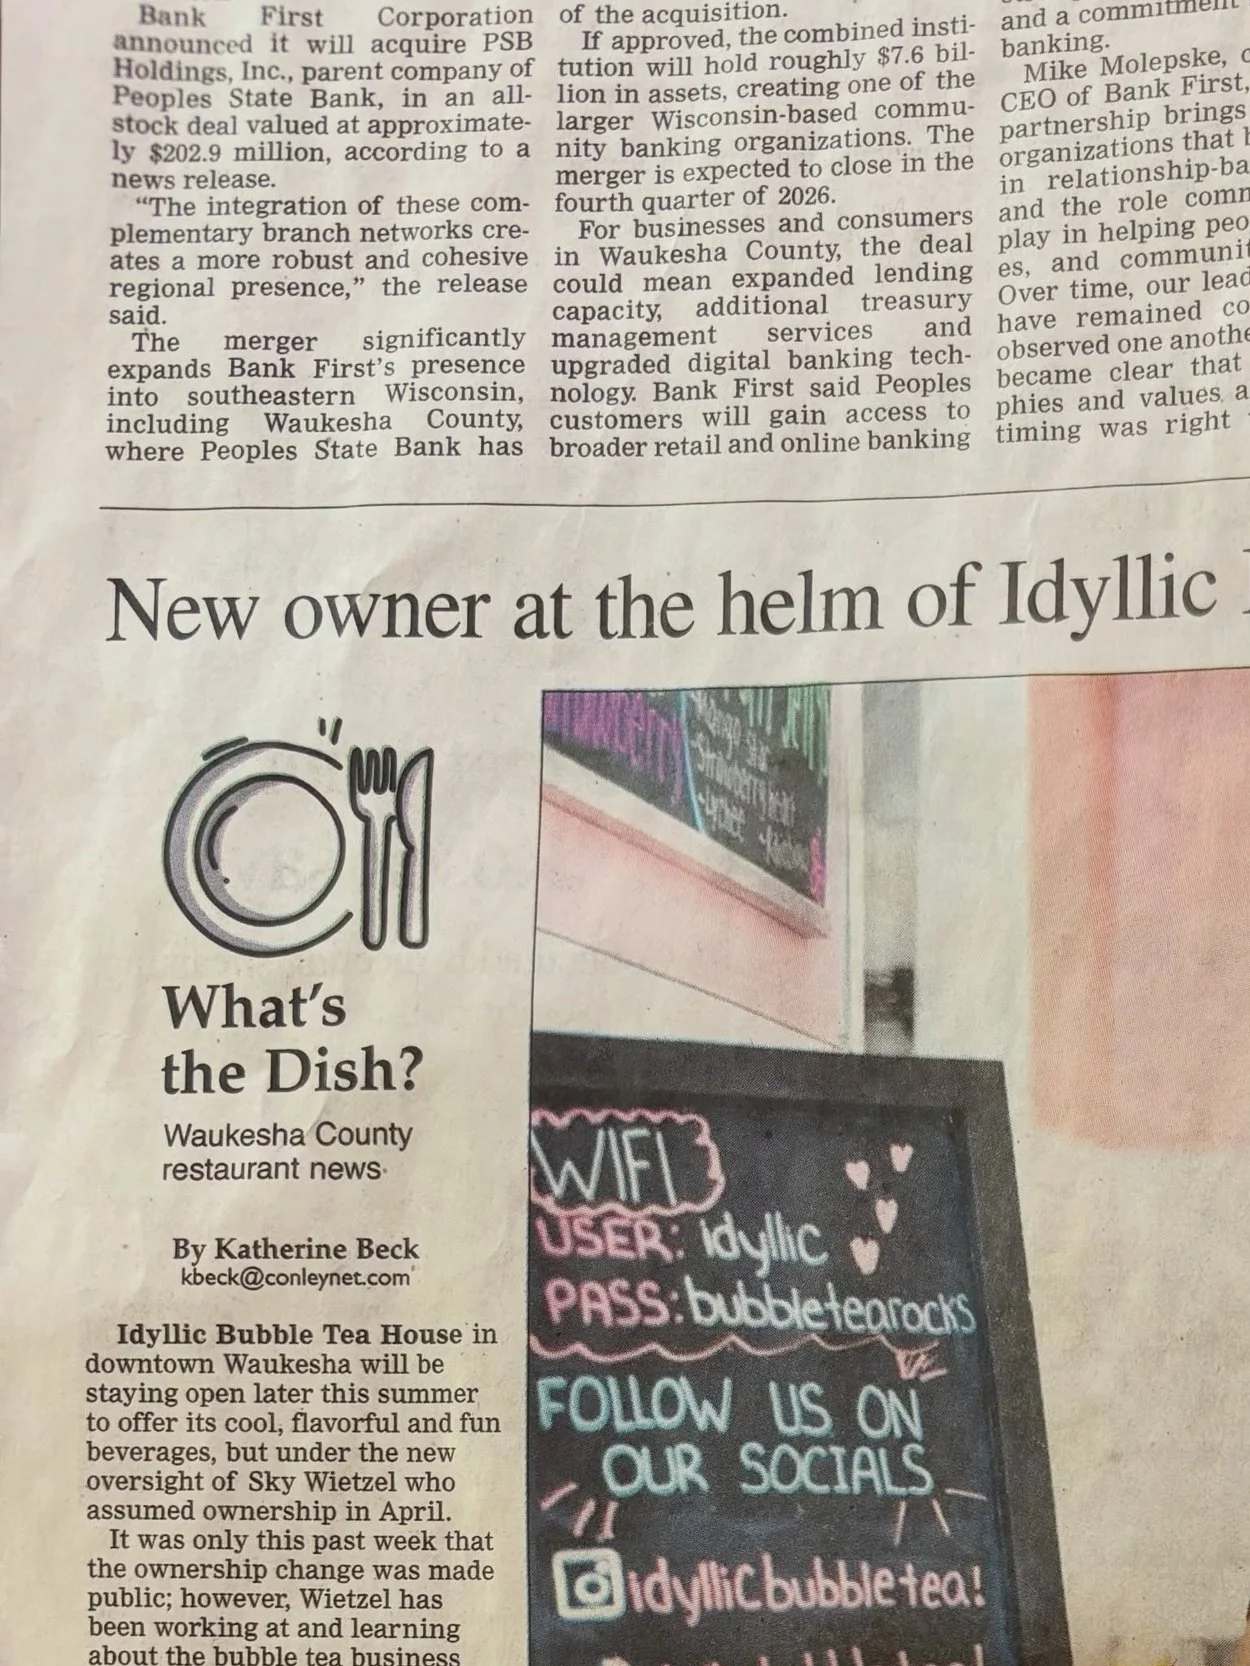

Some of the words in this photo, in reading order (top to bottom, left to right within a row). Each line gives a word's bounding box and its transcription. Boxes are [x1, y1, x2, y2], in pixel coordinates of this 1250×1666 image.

[1001, 32, 1109, 58] banking.
[112, 139, 136, 164] ly
[150, 143, 220, 164] $202.9
[234, 141, 330, 164] million,
[345, 142, 467, 162] according
[480, 140, 502, 158] to
[517, 142, 530, 158] a
[555, 192, 634, 212] fourth
[642, 190, 734, 215] quarter
[743, 185, 768, 205] of
[778, 186, 835, 205] 2026.
[108, 386, 158, 406] into
[188, 384, 355, 406] southeastern
[386, 382, 523, 404] Wisconsin,
[106, 578, 259, 641] New
[285, 593, 491, 639] owner
[514, 583, 573, 639] at
[596, 574, 694, 639] the
[718, 570, 883, 635] helm
[908, 561, 982, 627] of
[1000, 553, 1217, 641] Idyllic
[162, 1049, 245, 1094] the
[266, 1045, 423, 1092] Dish?
[164, 1122, 306, 1147] Waukesha
[316, 1121, 413, 1152] County
[164, 1158, 300, 1180] restaurant
[310, 1161, 382, 1180] news
[532, 1128, 677, 1203] WIFI
[172, 1238, 206, 1266] By
[214, 1237, 346, 1260] Katherine
[356, 1238, 420, 1260] Beck
[535, 1217, 686, 1262] USER:
[702, 1212, 828, 1278] idyllic
[182, 1266, 414, 1291] kbeck@conleynet.com
[544, 1276, 684, 1329] PASS:
[684, 1274, 977, 1335] bubbletearocks
[117, 1324, 206, 1348] Idyllic
[216, 1324, 313, 1344] Bubble
[323, 1324, 371, 1344] Tea
[380, 1324, 467, 1344] House
[473, 1323, 498, 1344] in
[536, 1374, 733, 1434] FOLLOW
[770, 1380, 835, 1440] US
[857, 1383, 924, 1441] ON
[602, 1444, 709, 1497] OUR
[740, 1443, 934, 1496] SOCIALS
